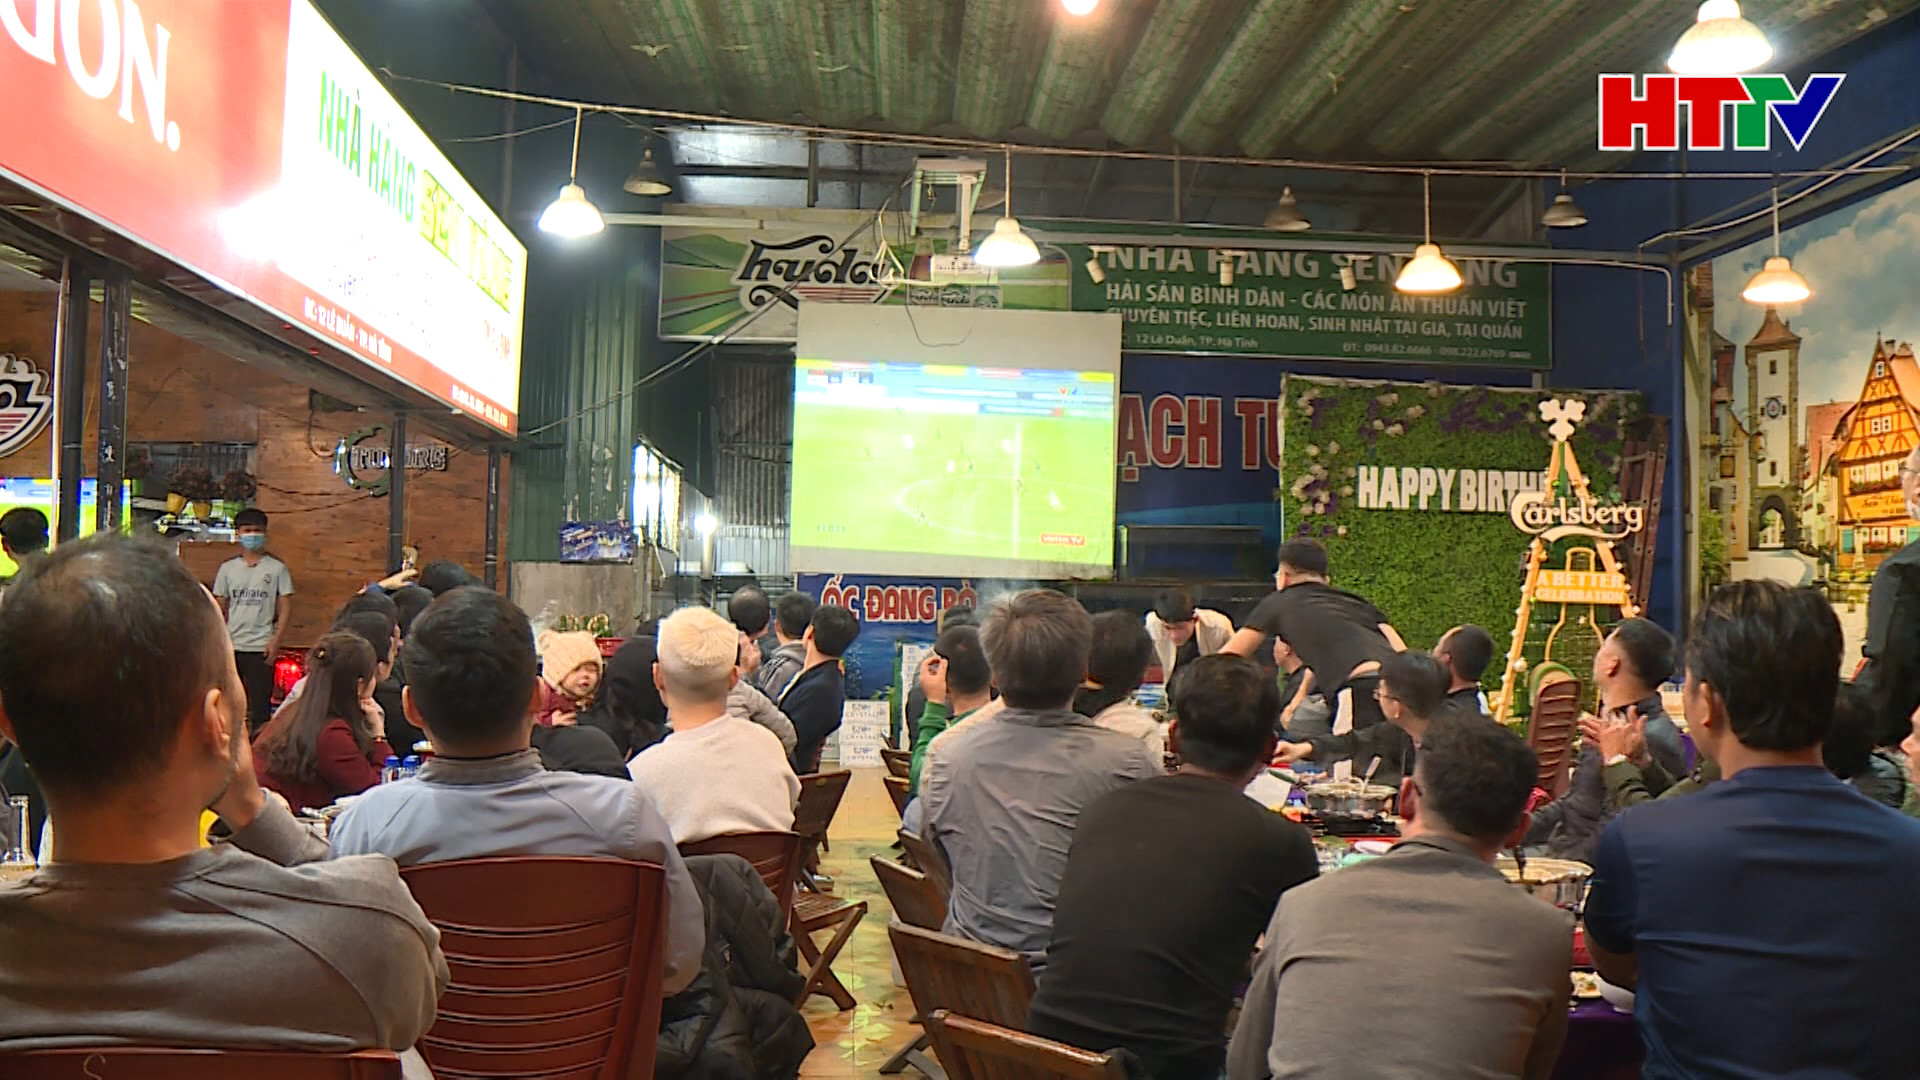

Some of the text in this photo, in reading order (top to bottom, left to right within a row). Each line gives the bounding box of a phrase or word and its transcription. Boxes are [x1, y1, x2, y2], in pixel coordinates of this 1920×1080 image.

[319, 70, 361, 178] NHÀ
[738, 235, 888, 284] huda
[1106, 278, 1141, 301] HẢI
[1146, 279, 1185, 303] SẢN
[1190, 283, 1240, 306] BÌNH
[1245, 285, 1285, 309] DÂN
[1301, 288, 1336, 311] CÁC
[1341, 289, 1385, 313] MÓN
[1487, 297, 1528, 320] VIỆT
[1174, 307, 1212, 329] TIỆC,
[1217, 307, 1252, 328] LIÊN
[1256, 314, 1305, 332] HOAN,
[1309, 317, 1346, 333] SINH
[1351, 316, 1391, 336] NHẬT
[1395, 320, 1418, 337] TẠI
[1421, 321, 1451, 338] GIA,
[1456, 323, 1478, 340] TẠI
[1481, 320, 1523, 340] QUÁN
[1358, 465, 1456, 512] HAPPY
[1511, 492, 1643, 540] Carlsberg
[821, 574, 860, 620] ỐC
[864, 585, 938, 623] ĐANG
[1536, 571, 1623, 588] A BETTER
